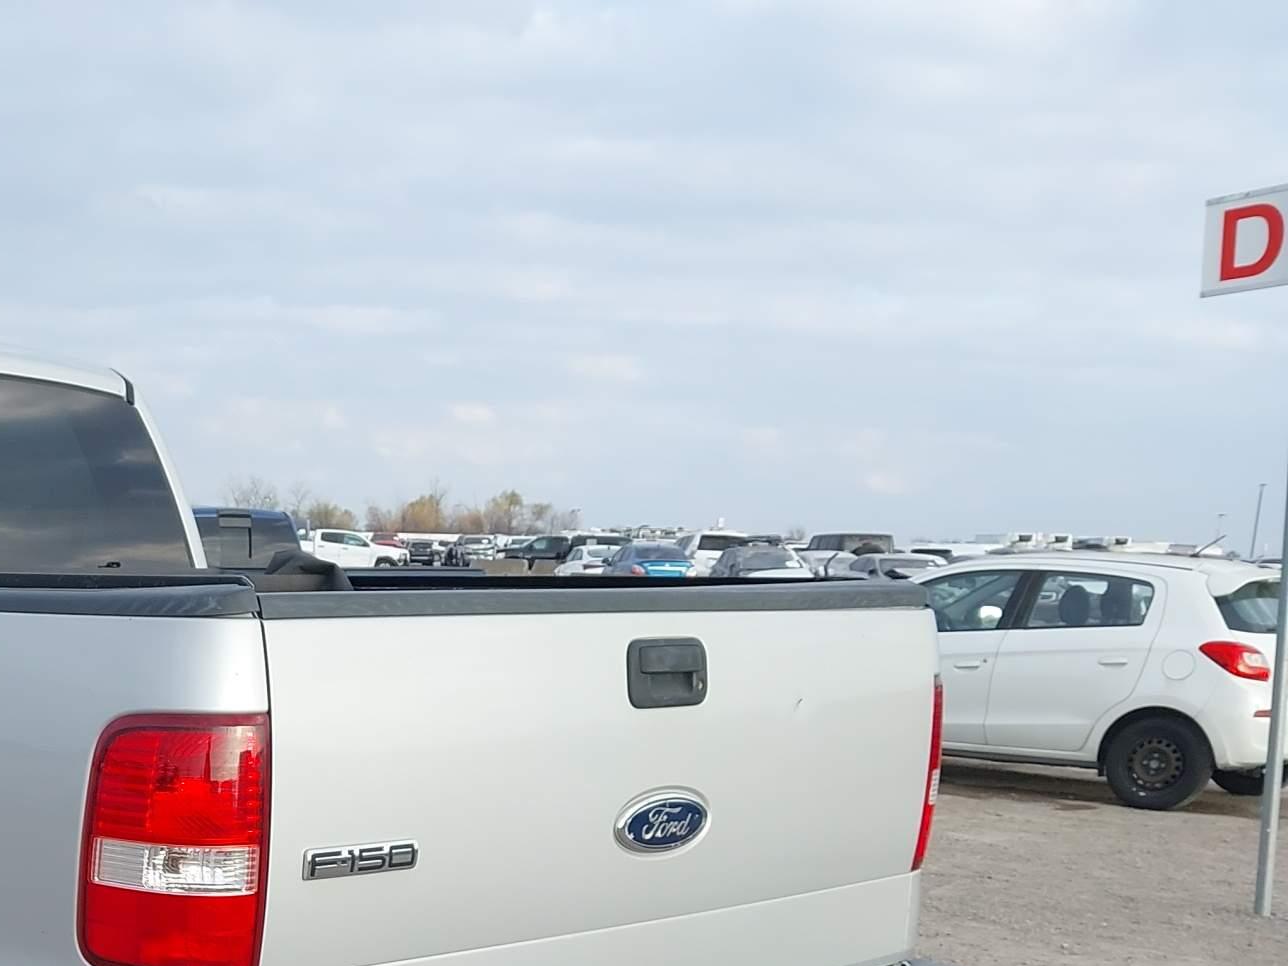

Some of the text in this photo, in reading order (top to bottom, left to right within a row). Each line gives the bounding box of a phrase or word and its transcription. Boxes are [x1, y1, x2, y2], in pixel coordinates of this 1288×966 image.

[1219, 203, 1285, 281] D
[641, 806, 693, 840] Ford
[309, 843, 416, 878] F-150
